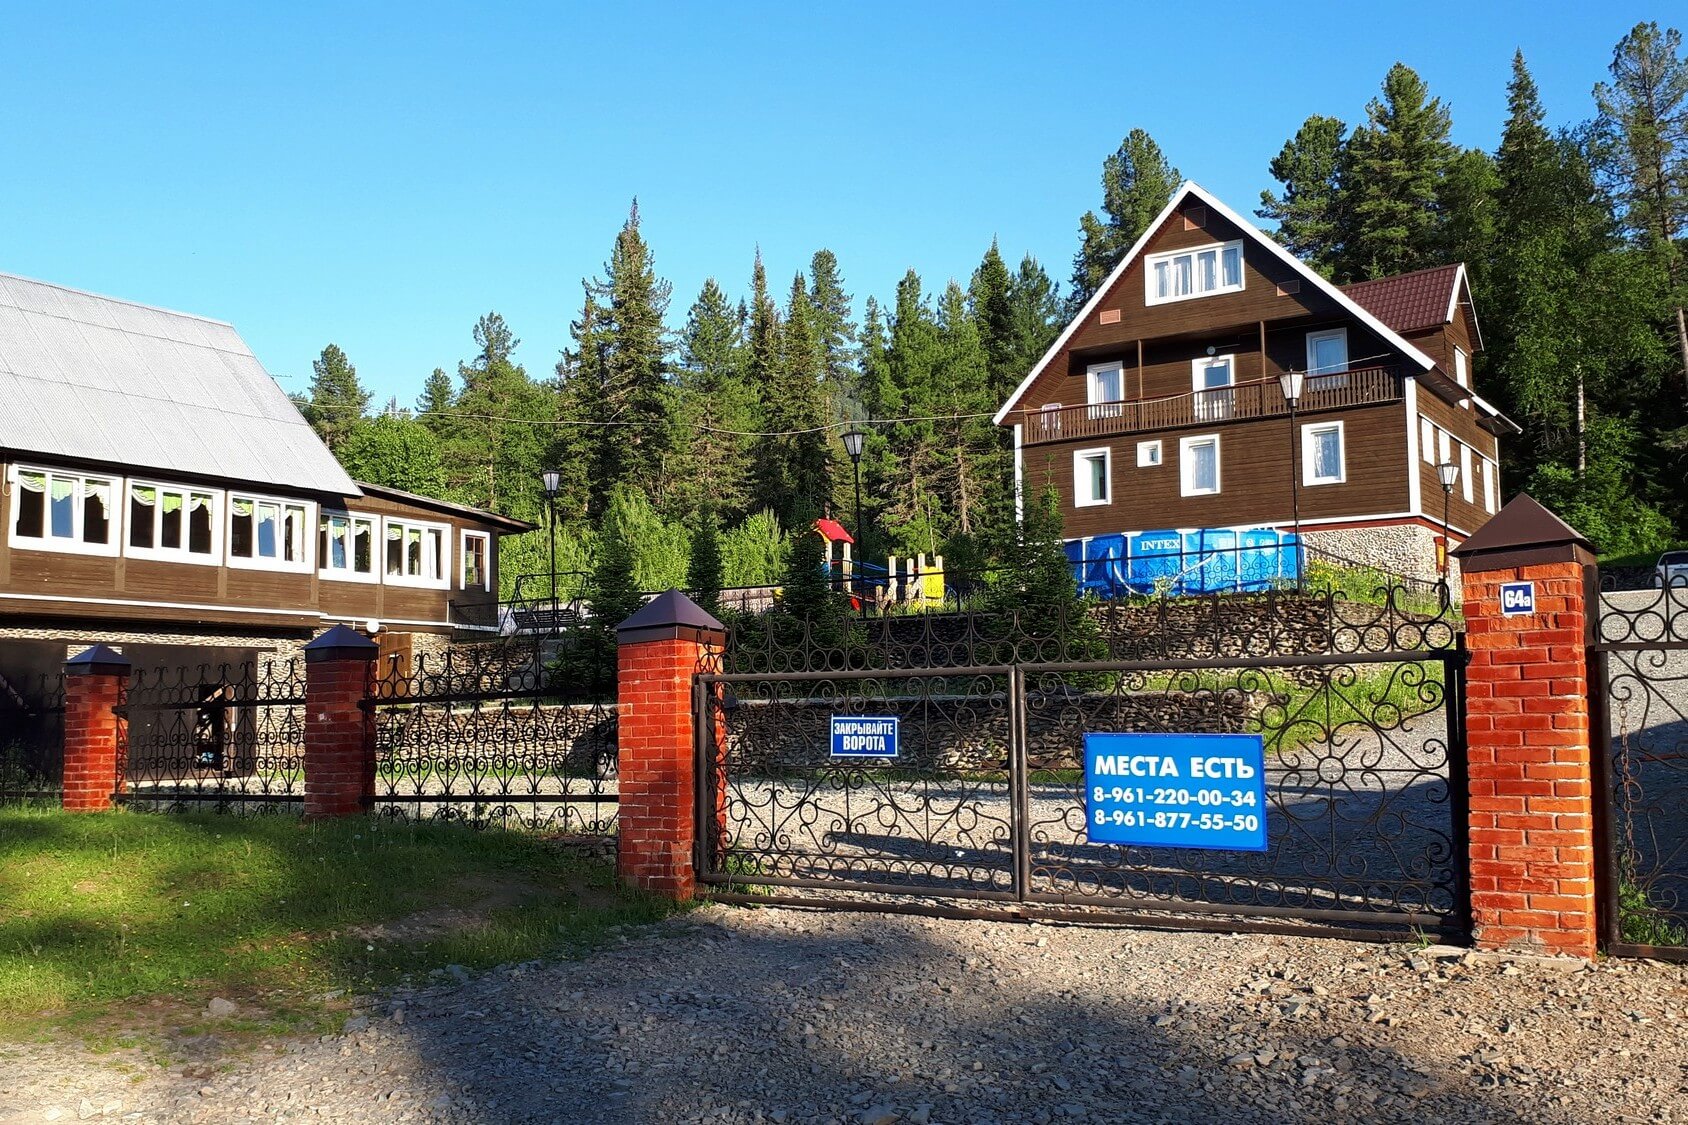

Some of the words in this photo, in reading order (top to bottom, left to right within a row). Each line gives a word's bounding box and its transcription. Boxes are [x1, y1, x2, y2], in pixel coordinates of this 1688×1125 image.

[1141, 539, 1180, 551] INTEX
[834, 720, 894, 735] ЗАКРЫВАЙТЕ
[842, 735, 886, 751] ВОРОТА
[1094, 755, 1180, 777] МЕСТА
[1190, 757, 1255, 779] ЕСТЬ
[1093, 786, 1256, 807] 8-961-220-00-34
[1094, 809, 1258, 831] 8-961-877-55-50
